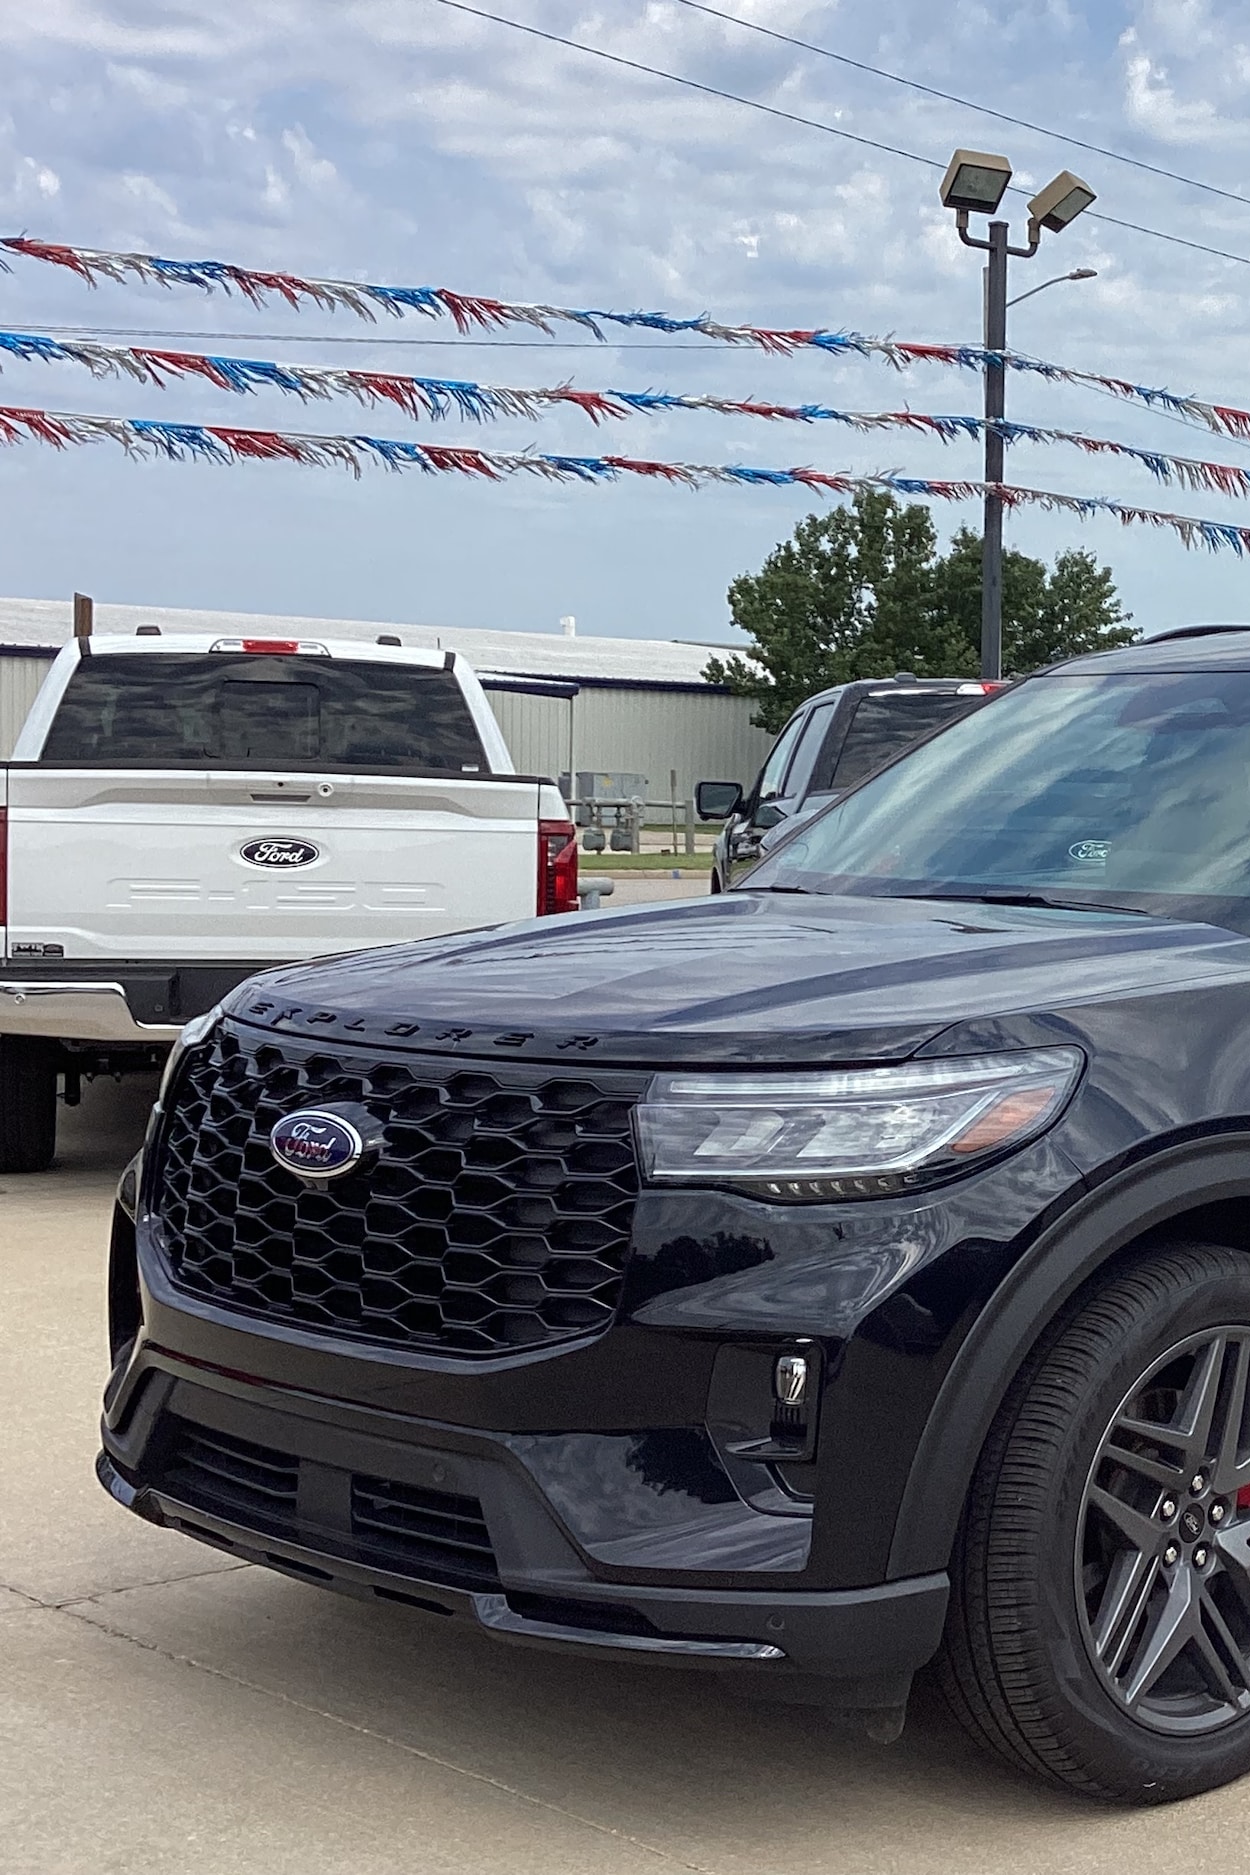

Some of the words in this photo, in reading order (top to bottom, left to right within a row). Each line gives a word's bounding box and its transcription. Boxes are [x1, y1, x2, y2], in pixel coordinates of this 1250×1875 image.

[254, 842, 305, 862] Ford
[249, 1002, 600, 1050] EXPLORER
[285, 1122, 336, 1163] Ford
